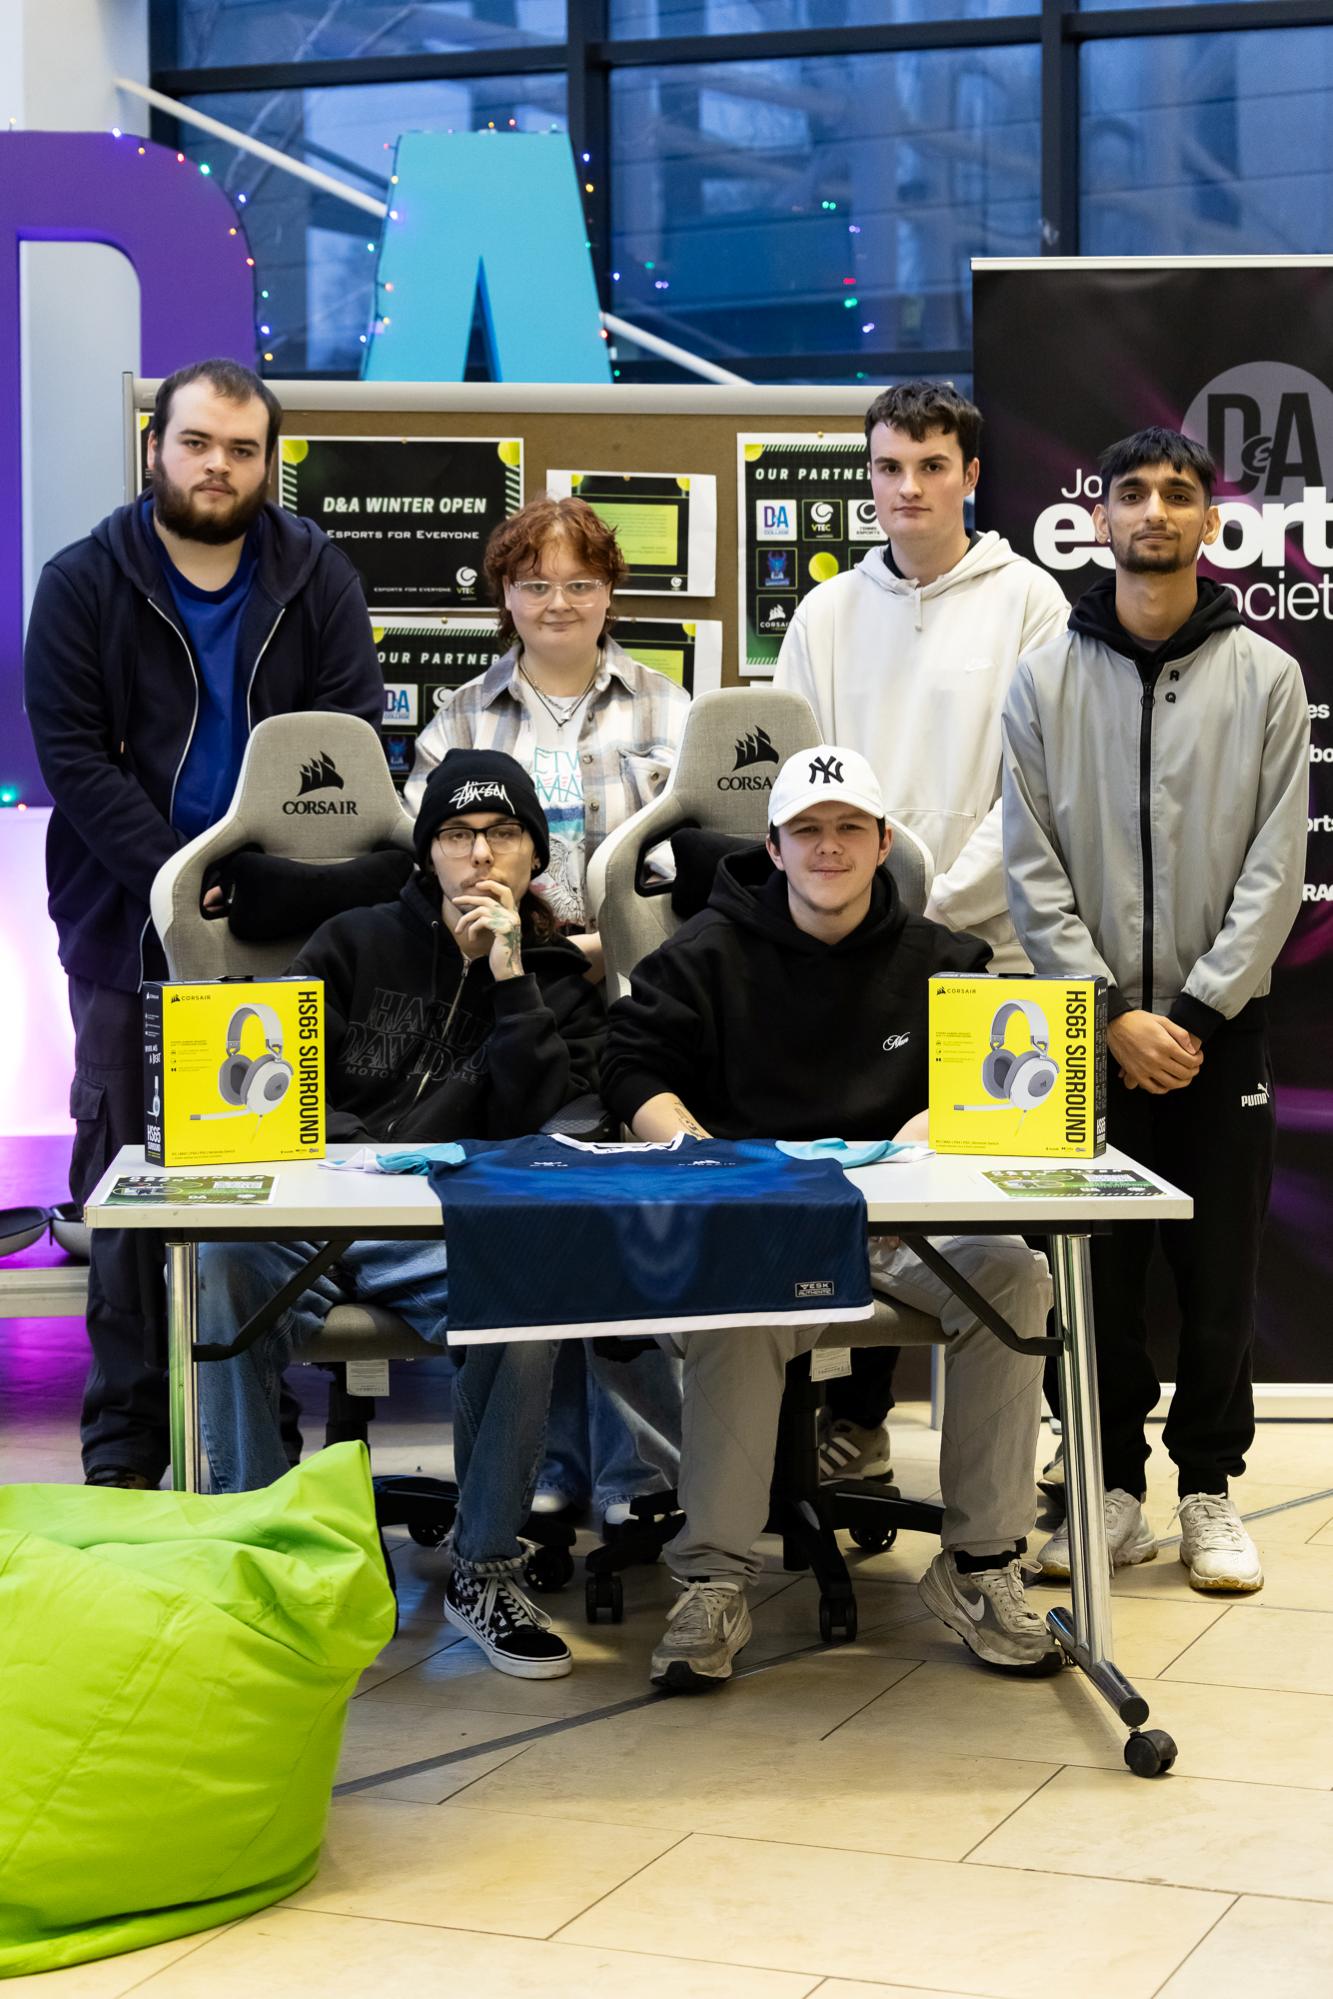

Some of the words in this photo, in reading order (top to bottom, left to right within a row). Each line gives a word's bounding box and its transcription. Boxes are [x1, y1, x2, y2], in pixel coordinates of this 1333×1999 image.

[755, 468, 789, 481] OUR
[797, 468, 872, 481] PARTNE
[1060, 468, 1103, 499] Jo
[323, 497, 361, 513] D&A
[366, 497, 435, 513] WINTER
[438, 497, 488, 514] OPEN
[1033, 486, 1333, 570] eort
[1222, 570, 1333, 622] ociet
[759, 621, 790, 629] CORSAI
[377, 652, 411, 664] OUR
[1308, 704, 1331, 719] es
[1310, 744, 1333, 763] bo
[808, 755, 845, 785] NY
[717, 776, 774, 792] CORSA
[282, 800, 359, 816] CORSAIR
[1308, 815, 1333, 832] rts
[298, 991, 319, 1040] HS65
[1065, 990, 1087, 1039] HS65
[298, 1045, 319, 1145] SURROUND
[1065, 1044, 1087, 1144] SURROUND
[1241, 1092, 1268, 1107] PUMA
